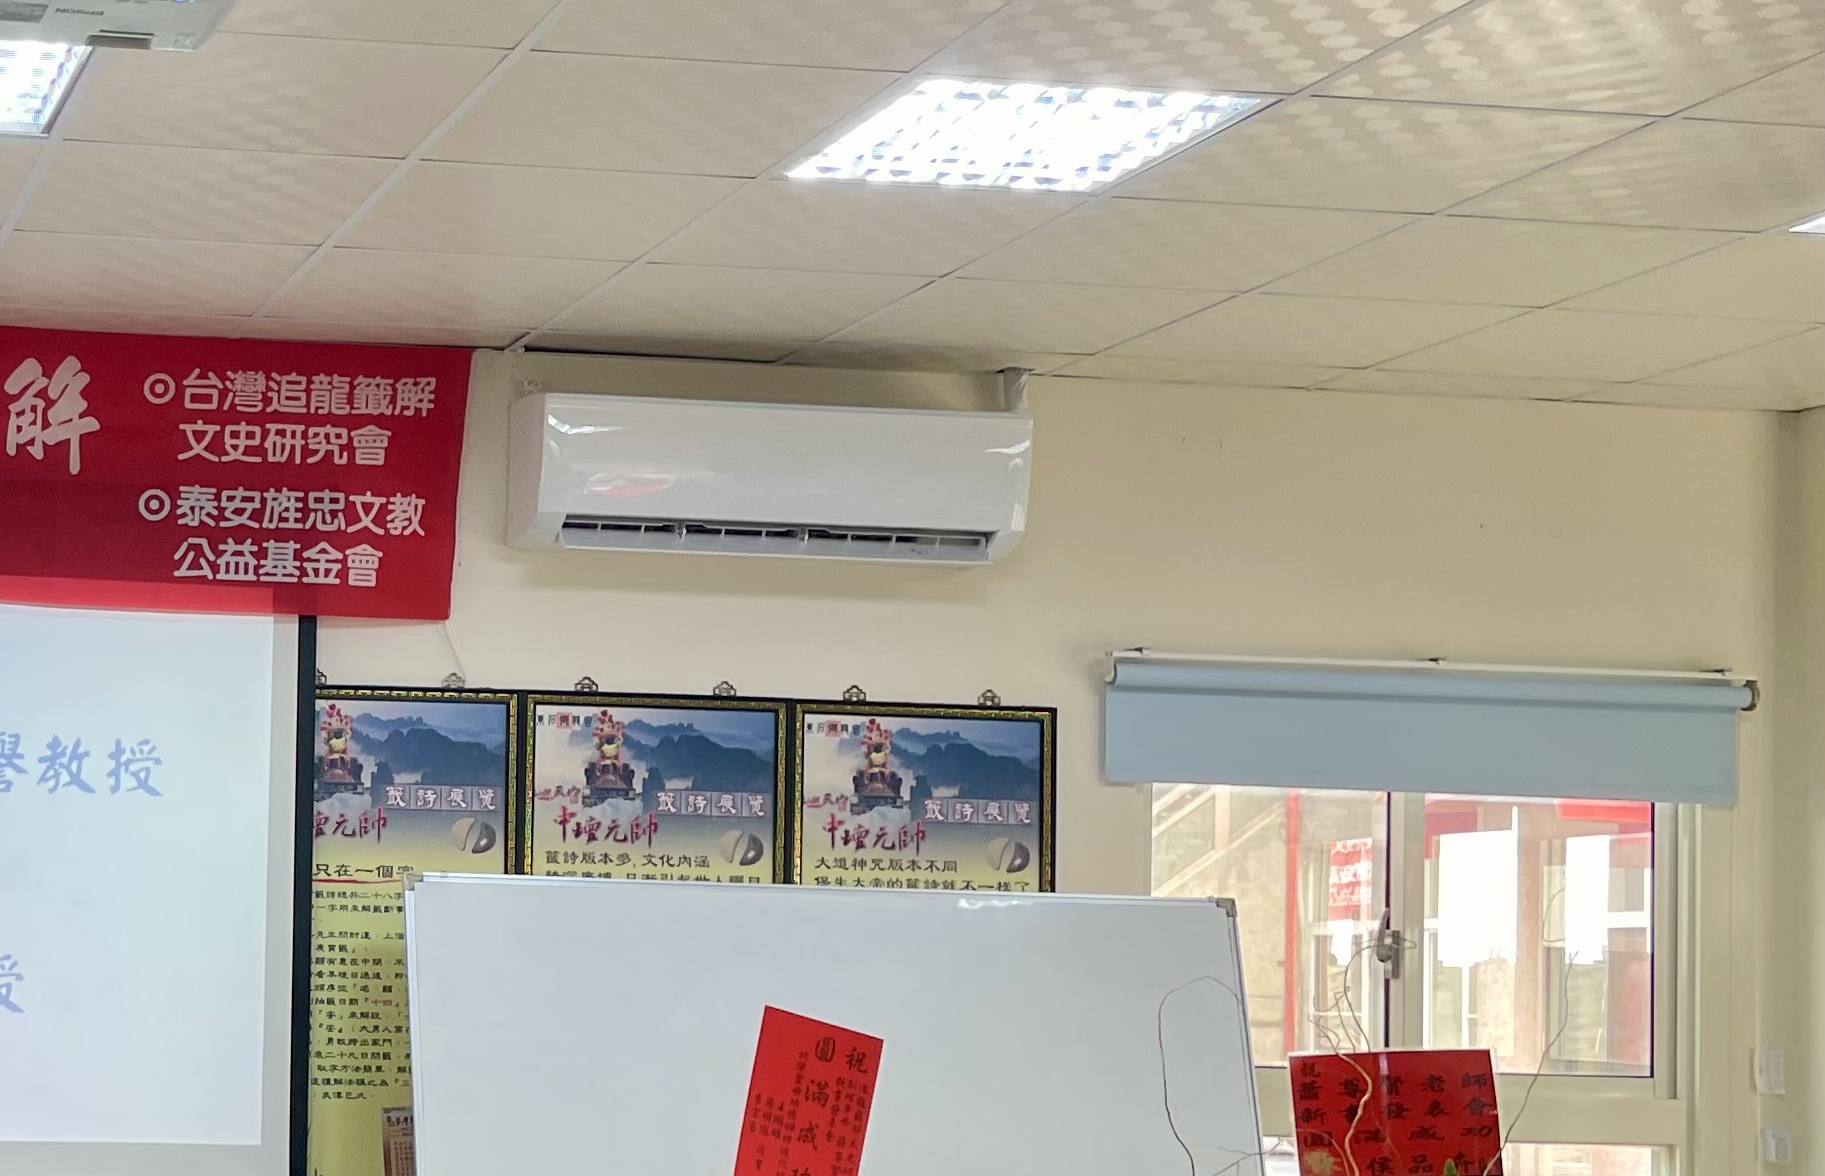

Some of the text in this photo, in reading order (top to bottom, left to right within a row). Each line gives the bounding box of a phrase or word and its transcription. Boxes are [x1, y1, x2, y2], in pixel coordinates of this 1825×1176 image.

[176, 421, 392, 467] 文史研究會
[172, 538, 382, 588] 公益基金會
[845, 1045, 869, 1074] 祝
